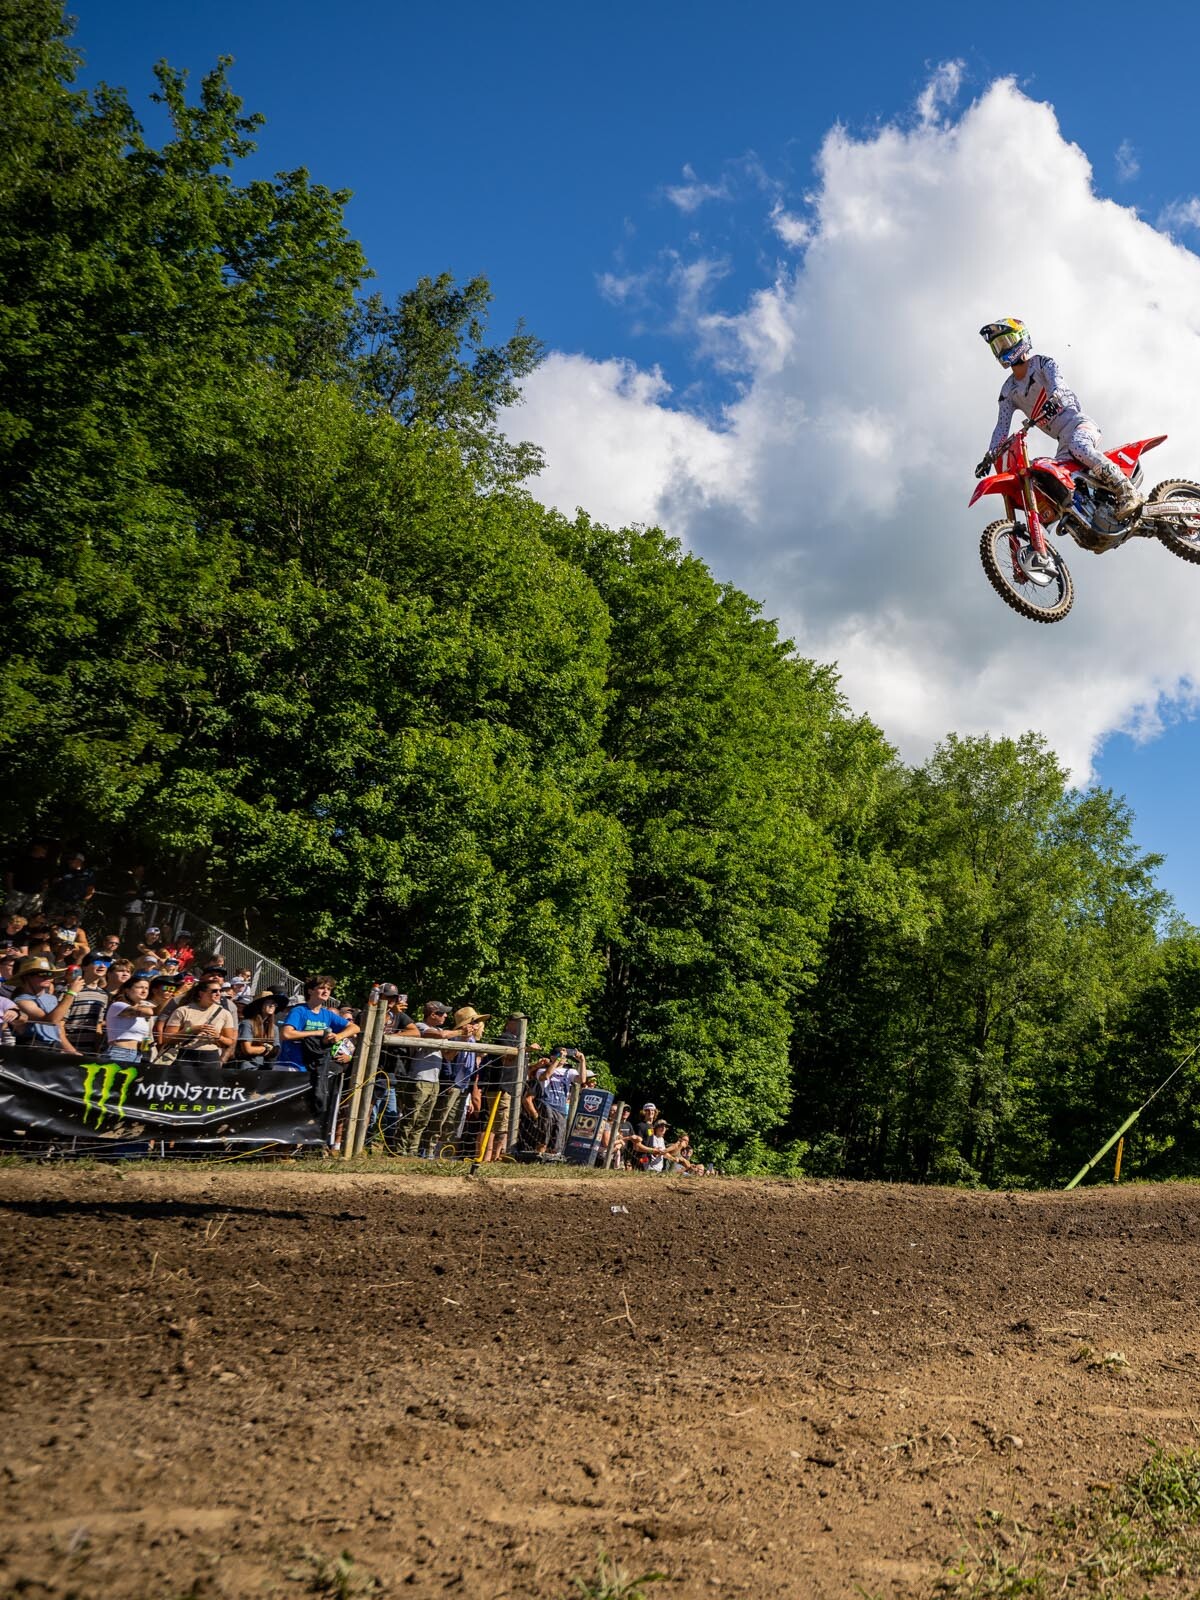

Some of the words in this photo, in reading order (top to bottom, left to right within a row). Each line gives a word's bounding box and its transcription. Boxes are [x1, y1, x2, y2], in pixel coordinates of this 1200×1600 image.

[135, 1081, 246, 1101] MONSTER
[150, 1103, 228, 1112] ENERGY
[576, 1116, 596, 1129] 50
